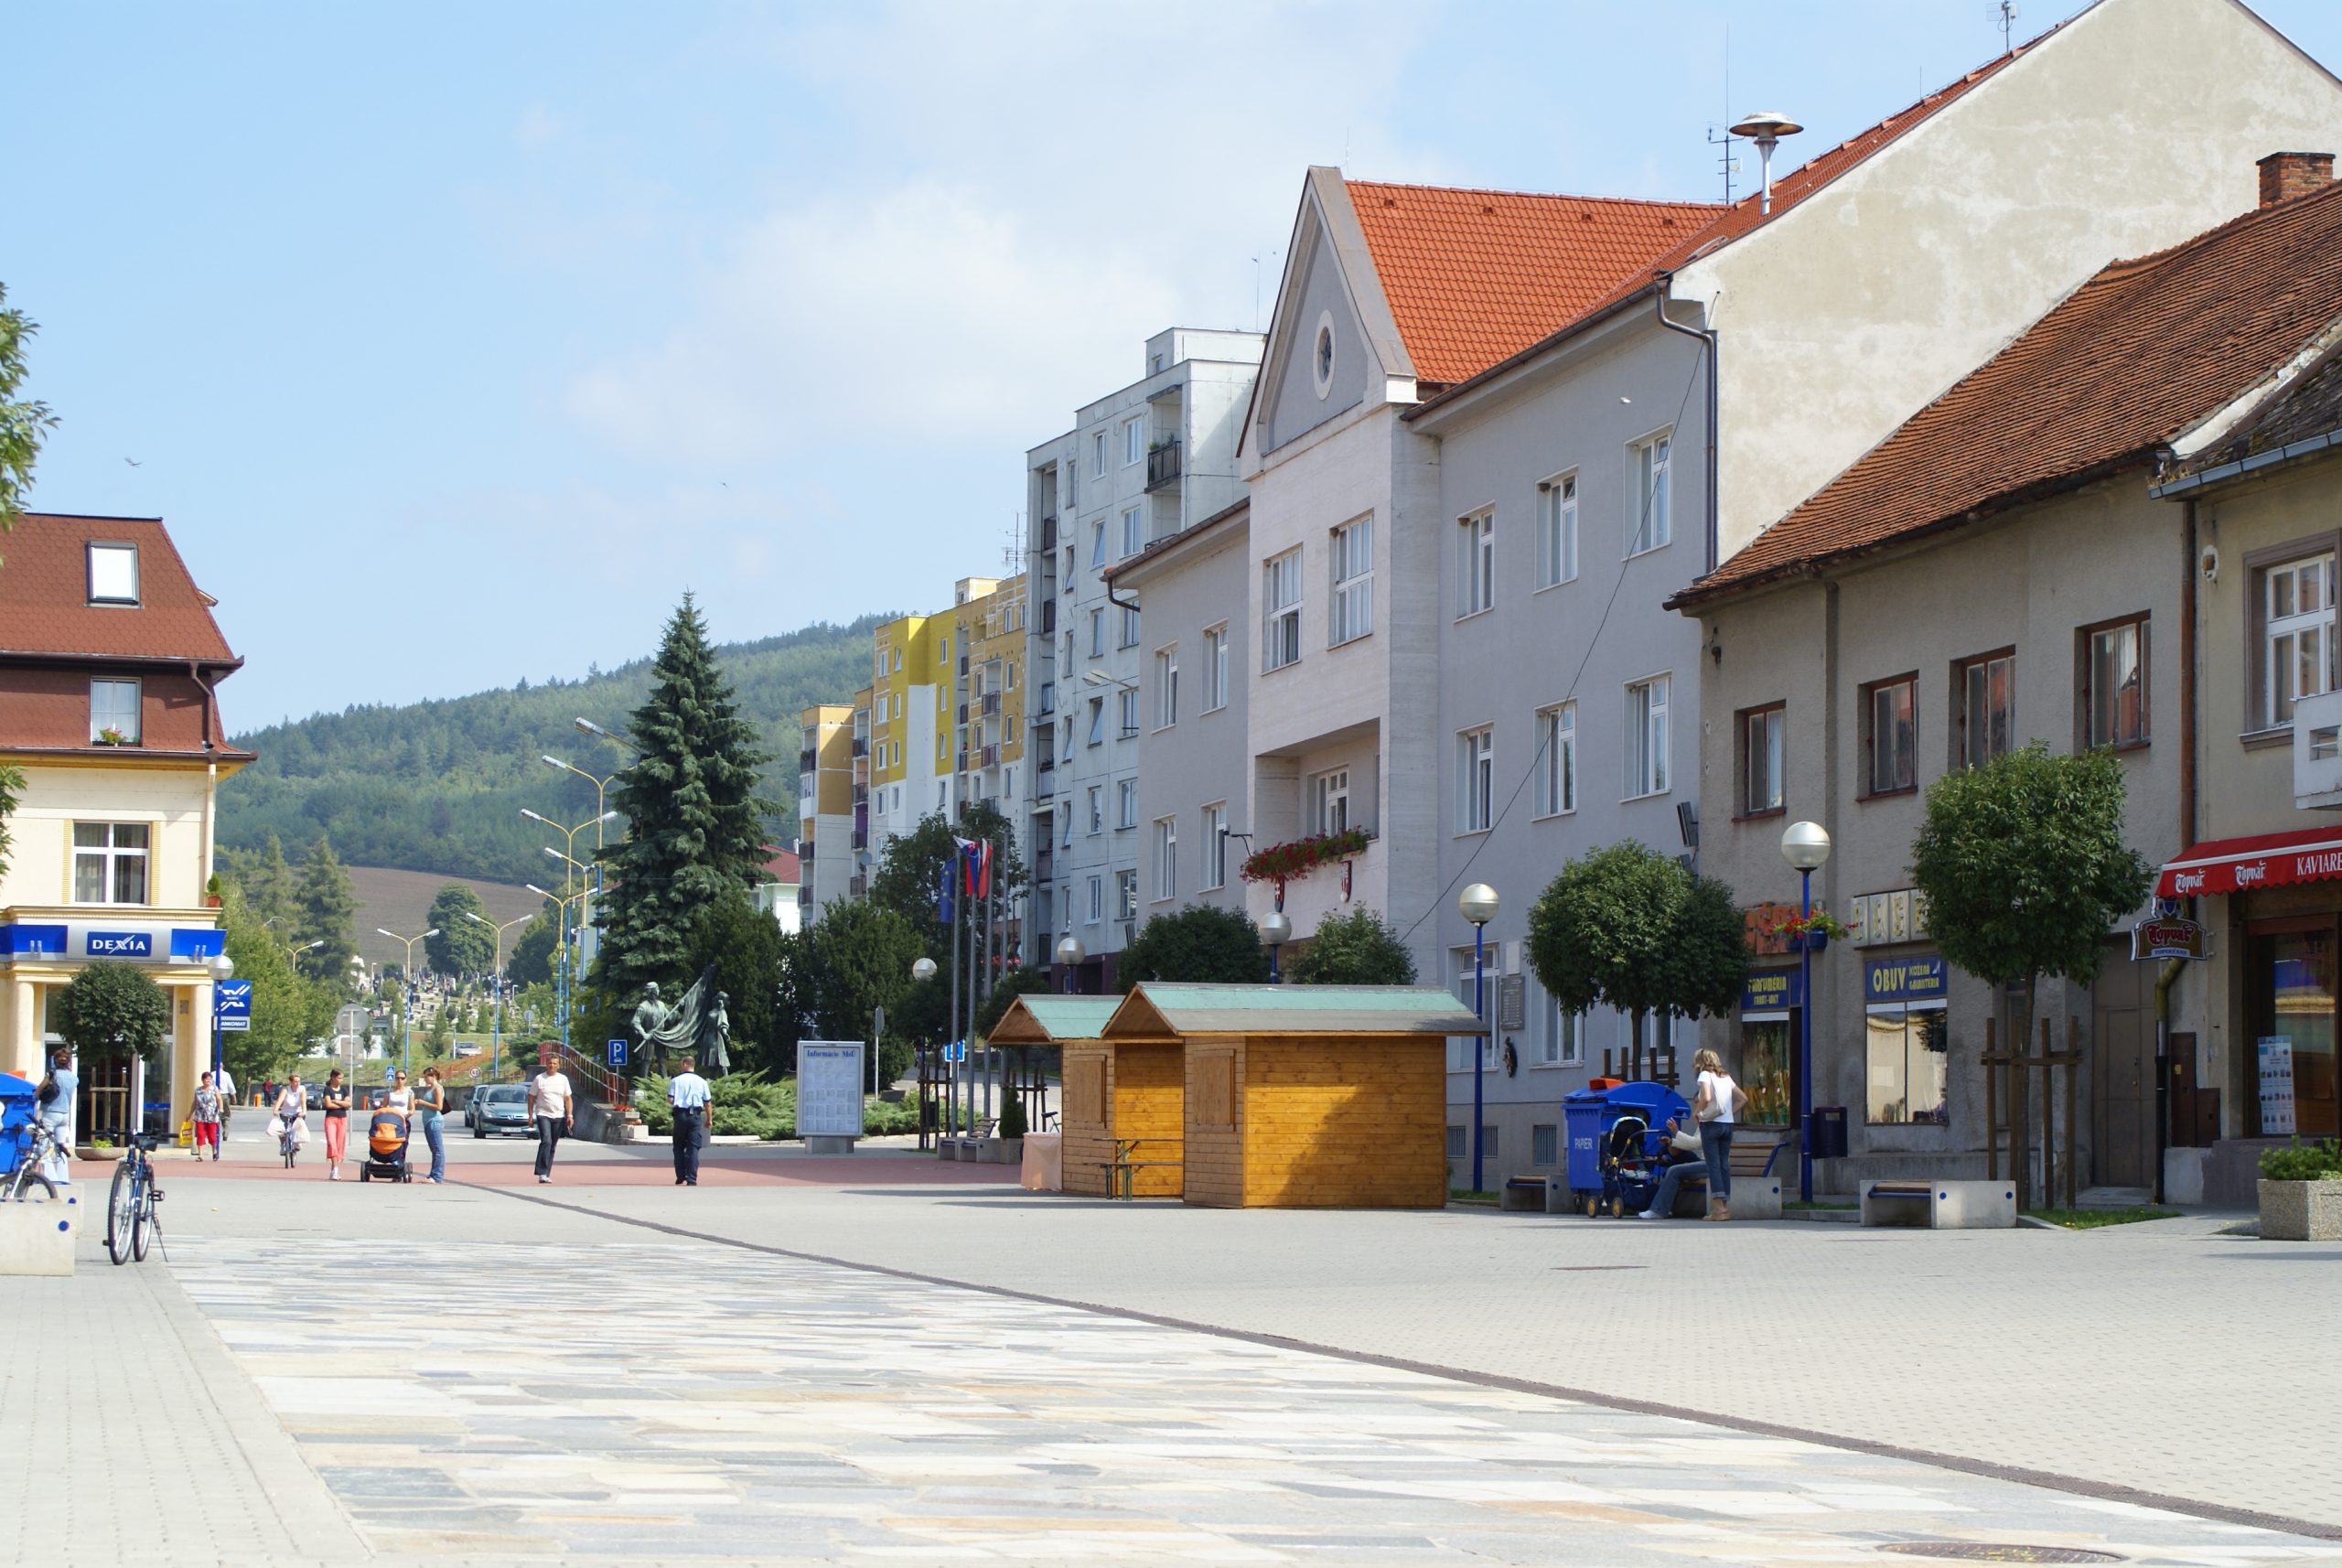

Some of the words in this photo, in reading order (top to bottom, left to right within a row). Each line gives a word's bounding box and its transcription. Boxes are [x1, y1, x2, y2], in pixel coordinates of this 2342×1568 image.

[92, 935, 146, 954] DEXIA
[1873, 967, 1907, 993] OBUV
[614, 1043, 622, 1057] P
[1574, 1137, 1593, 1149] PAPIER
